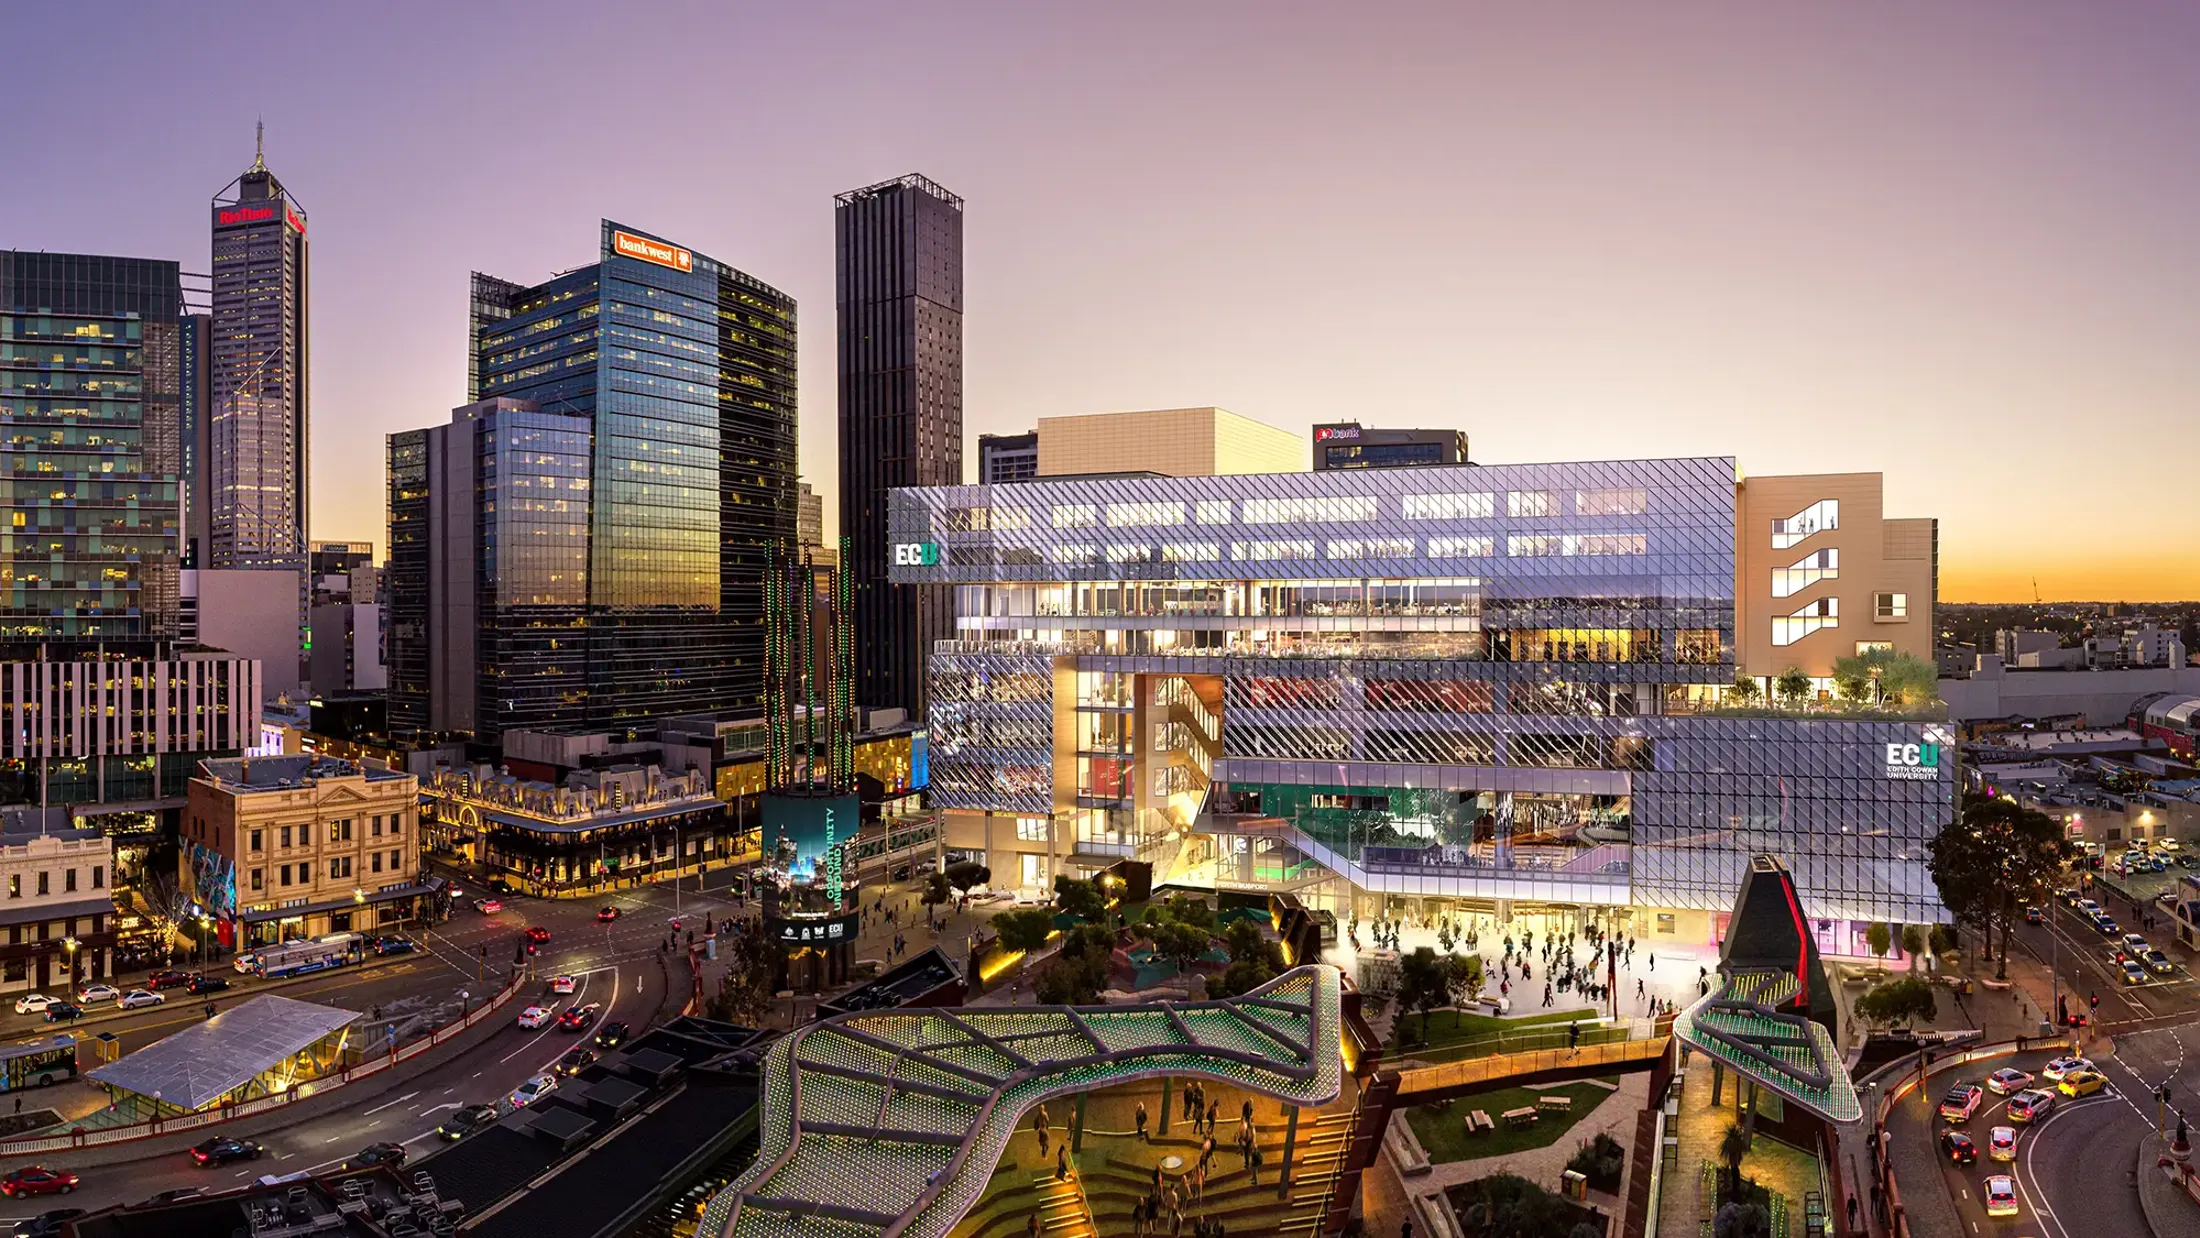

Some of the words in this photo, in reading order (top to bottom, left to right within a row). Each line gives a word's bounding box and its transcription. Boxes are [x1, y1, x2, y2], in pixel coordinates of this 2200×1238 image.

[619, 234, 673, 262] bankwest
[895, 543, 939, 566] ECU
[1887, 743, 1939, 766] ECU
[1887, 772, 1938, 780] UNIVERSITY
[1911, 766, 1938, 774] COWAN
[826, 808, 835, 899] OPPORTUNITY
[834, 848, 843, 911] UNBOUND
[1239, 882, 1269, 890] BUSPORT
[828, 923, 844, 933] ECU
